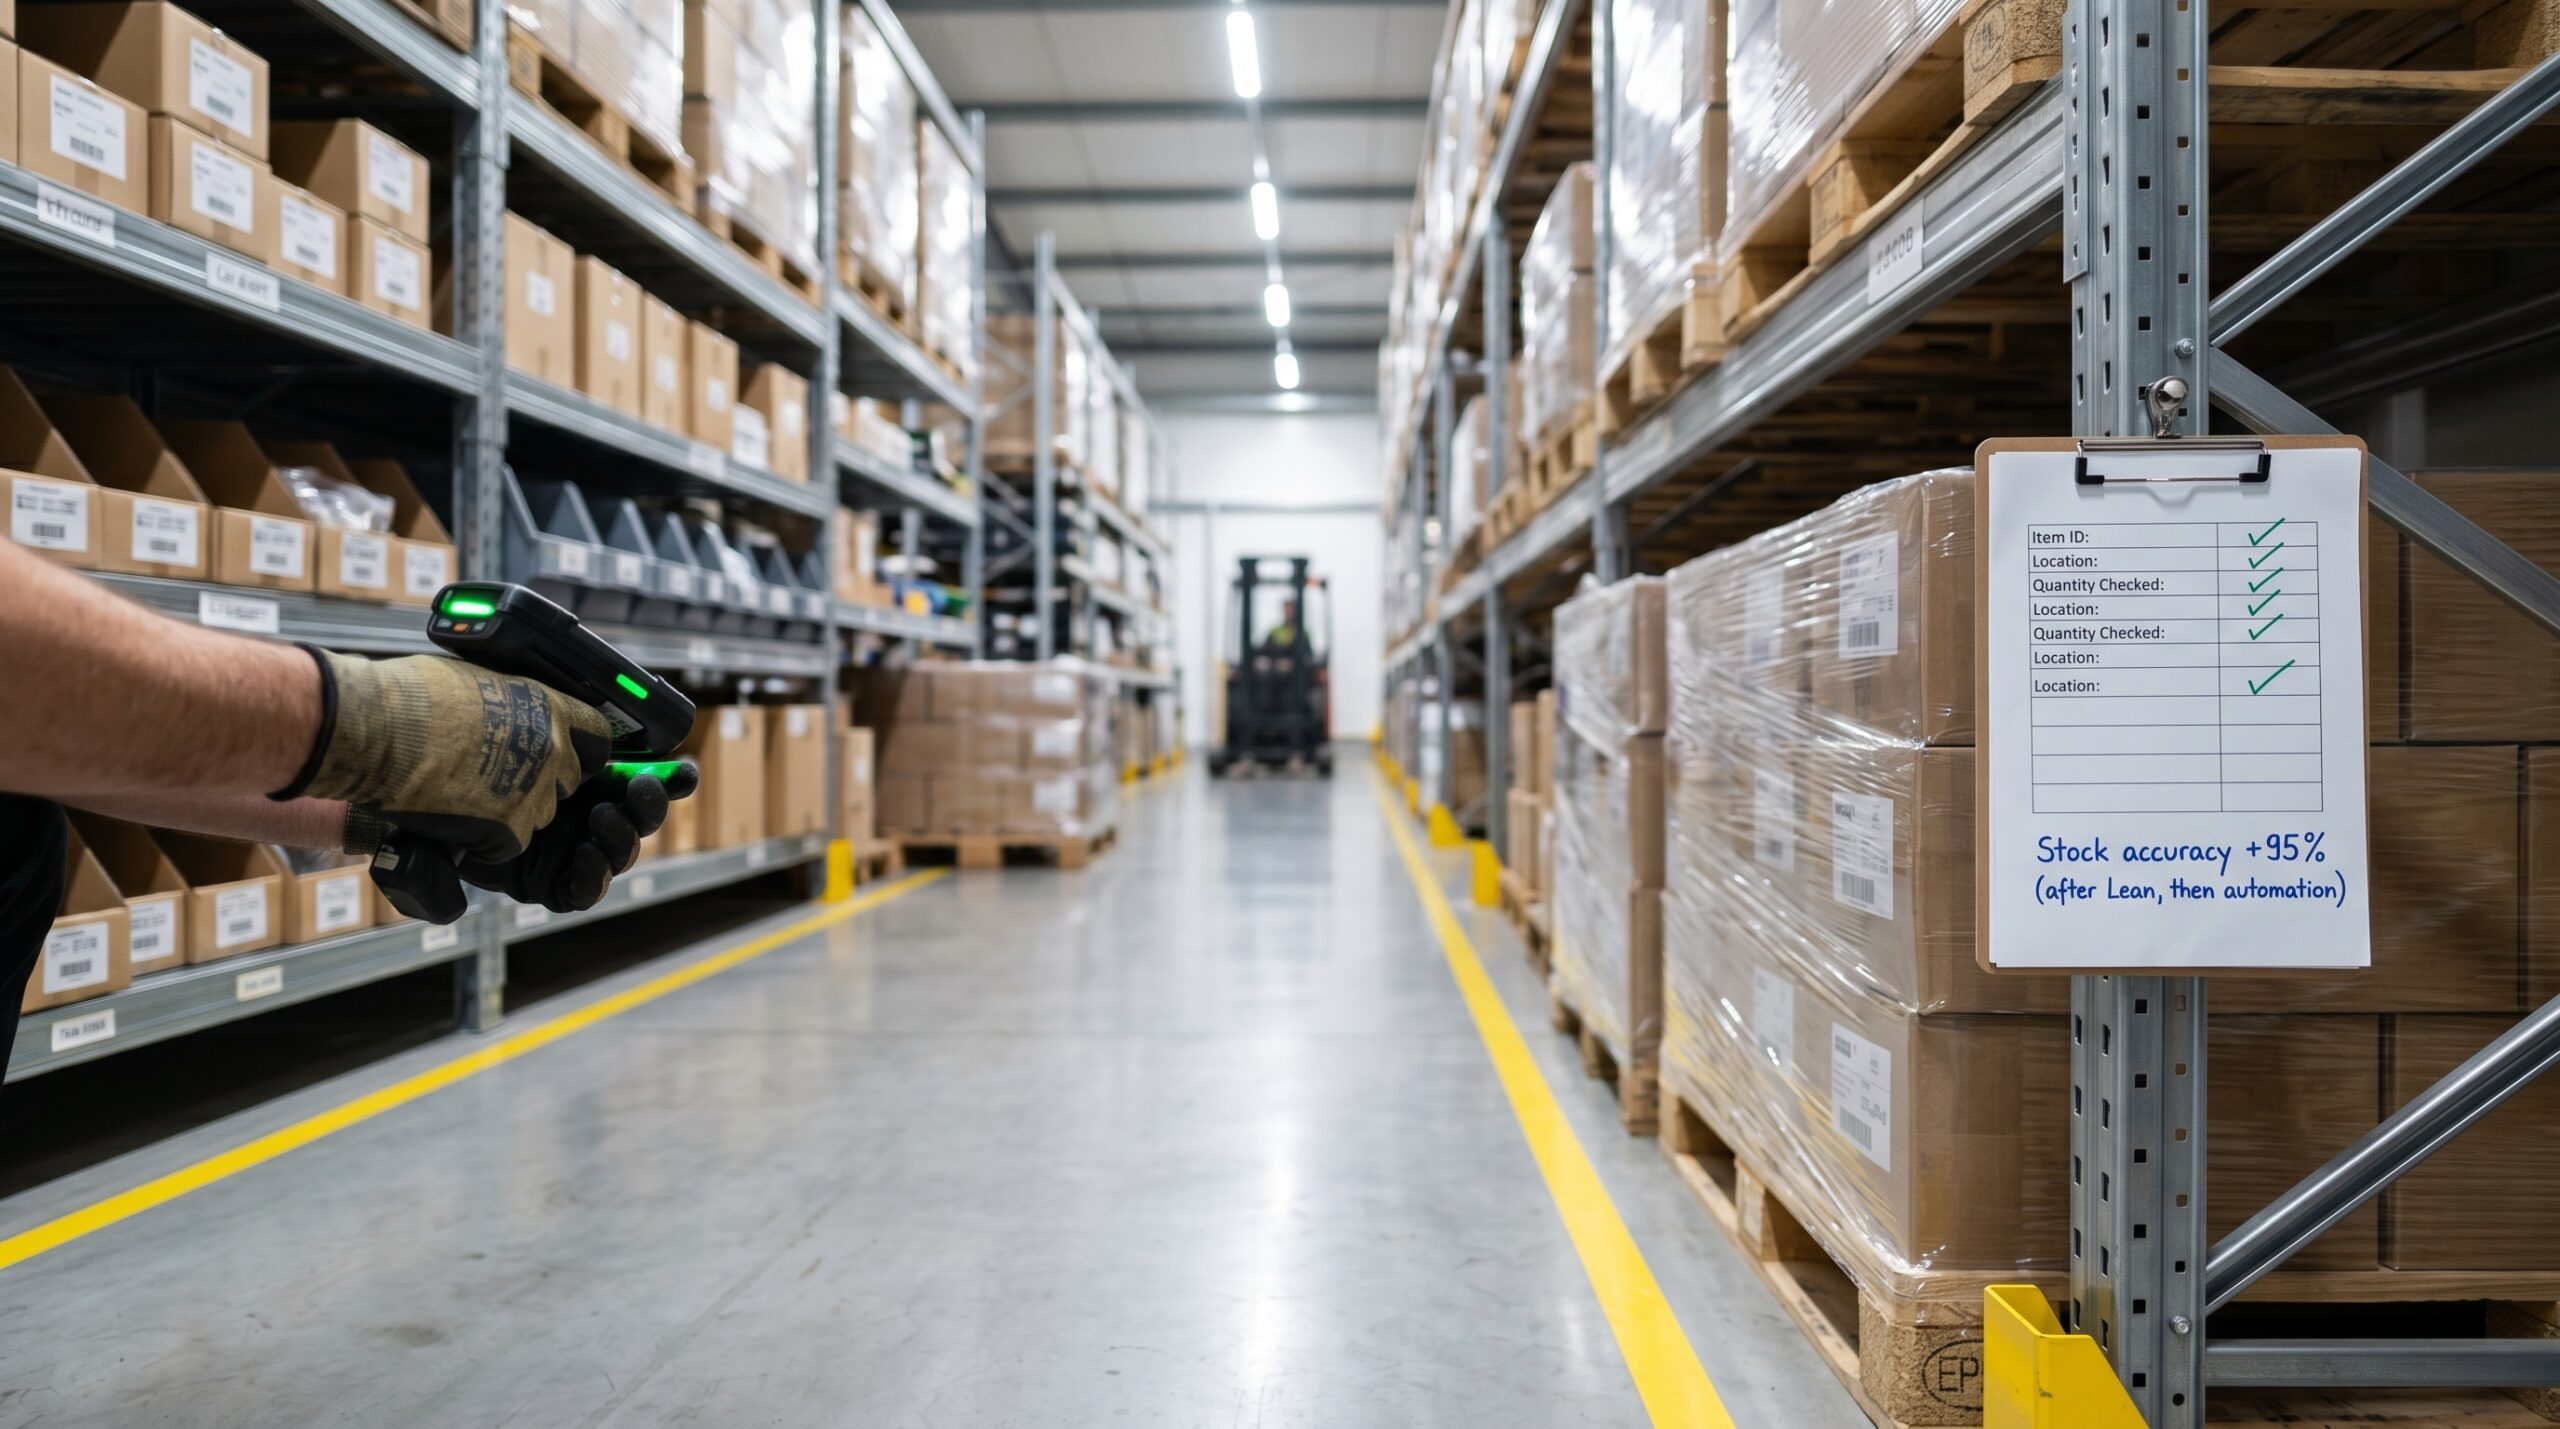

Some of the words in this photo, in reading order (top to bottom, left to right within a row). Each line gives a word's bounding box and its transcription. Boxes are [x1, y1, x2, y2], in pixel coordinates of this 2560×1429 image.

[2032, 530, 2065, 544] Item
[2069, 530, 2089, 543] ID:
[2032, 554, 2098, 568] Location:
[2032, 578, 2096, 594] Quantity
[2099, 577, 2165, 591] Checked:
[2033, 602, 2099, 616] Location:
[2033, 626, 2096, 642] Quantity
[2099, 625, 2166, 640] Checked:
[2034, 650, 2100, 664] Location:
[2034, 679, 2101, 693] Location:
[2036, 835, 2110, 863] Stock
[2122, 844, 2232, 877] accuracy
[2245, 831, 2326, 863] +95%
[2035, 874, 2097, 906] (after
[2106, 876, 2164, 905] Lean,
[2169, 877, 2216, 899] then
[2223, 869, 2347, 908] automation)
[1939, 1355, 1984, 1394] EP
